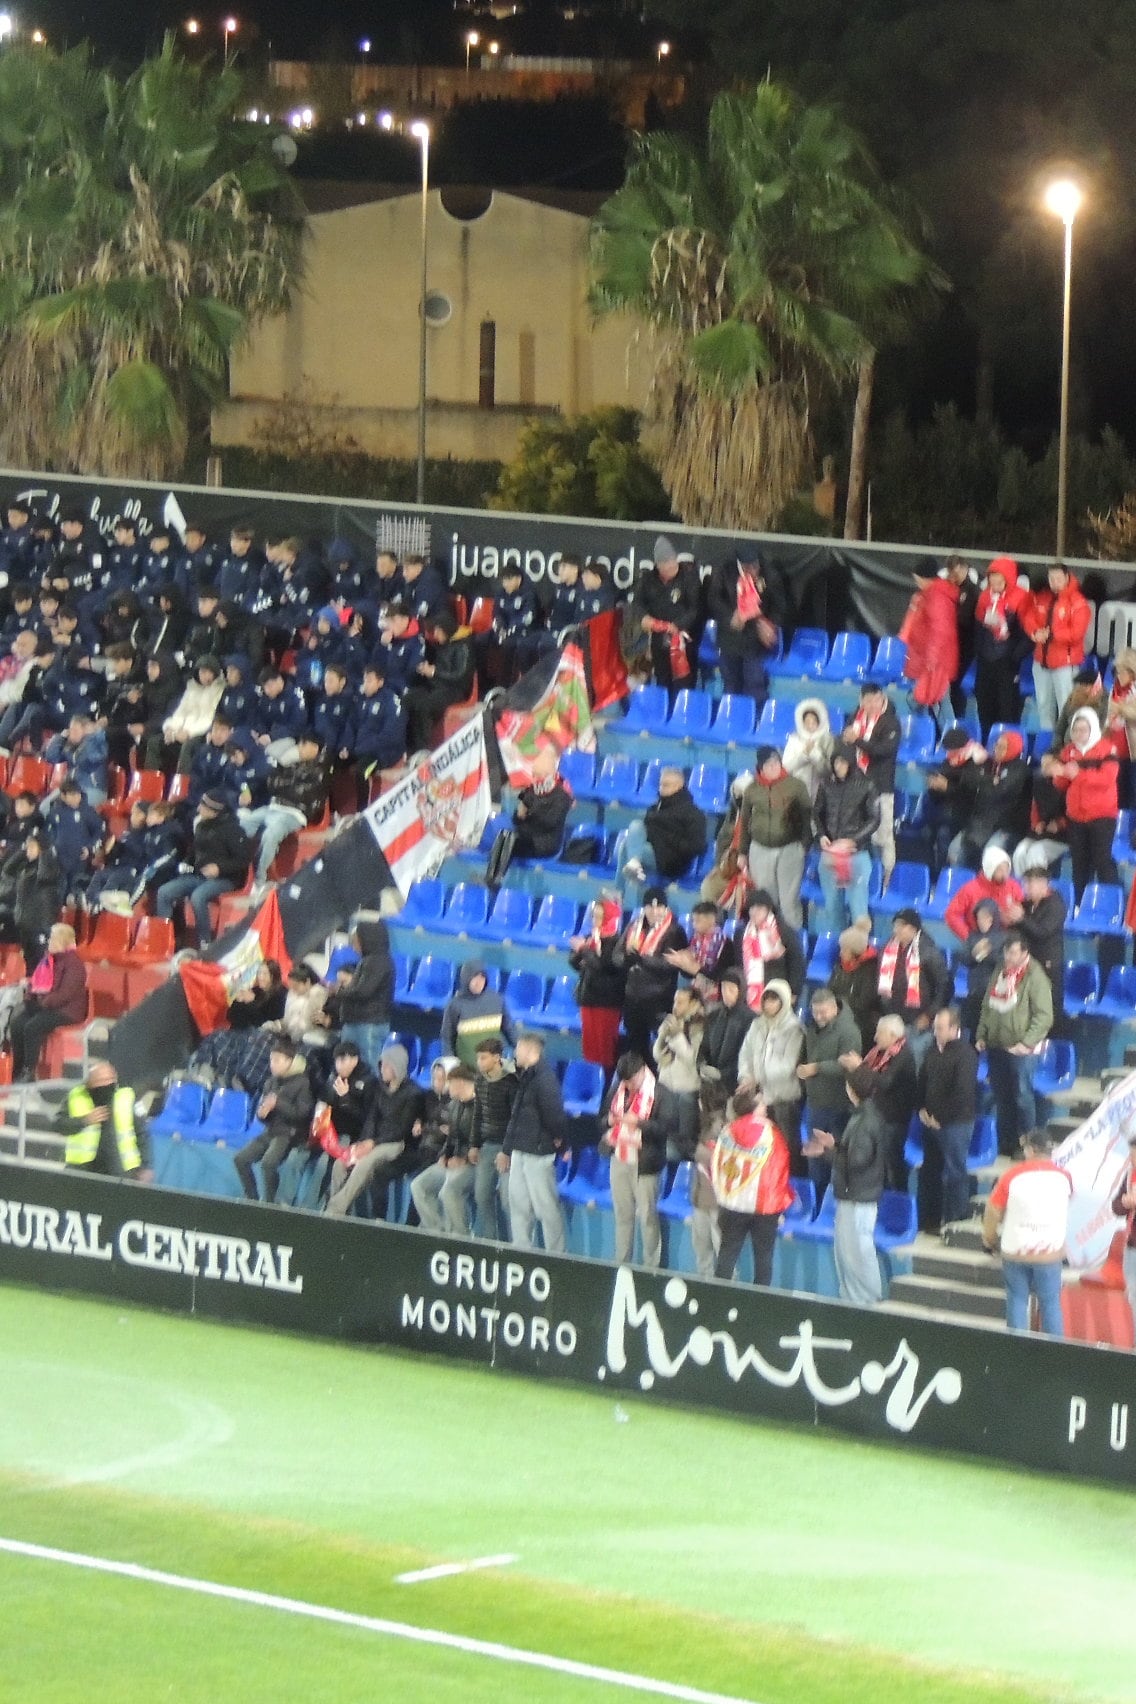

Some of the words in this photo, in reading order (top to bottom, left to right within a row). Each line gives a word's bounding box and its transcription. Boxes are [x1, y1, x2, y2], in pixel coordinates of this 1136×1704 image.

[118, 1220, 303, 1293] CENTRAL
[430, 1250, 551, 1301] GRUPO
[401, 1293, 577, 1356] MONTORO
